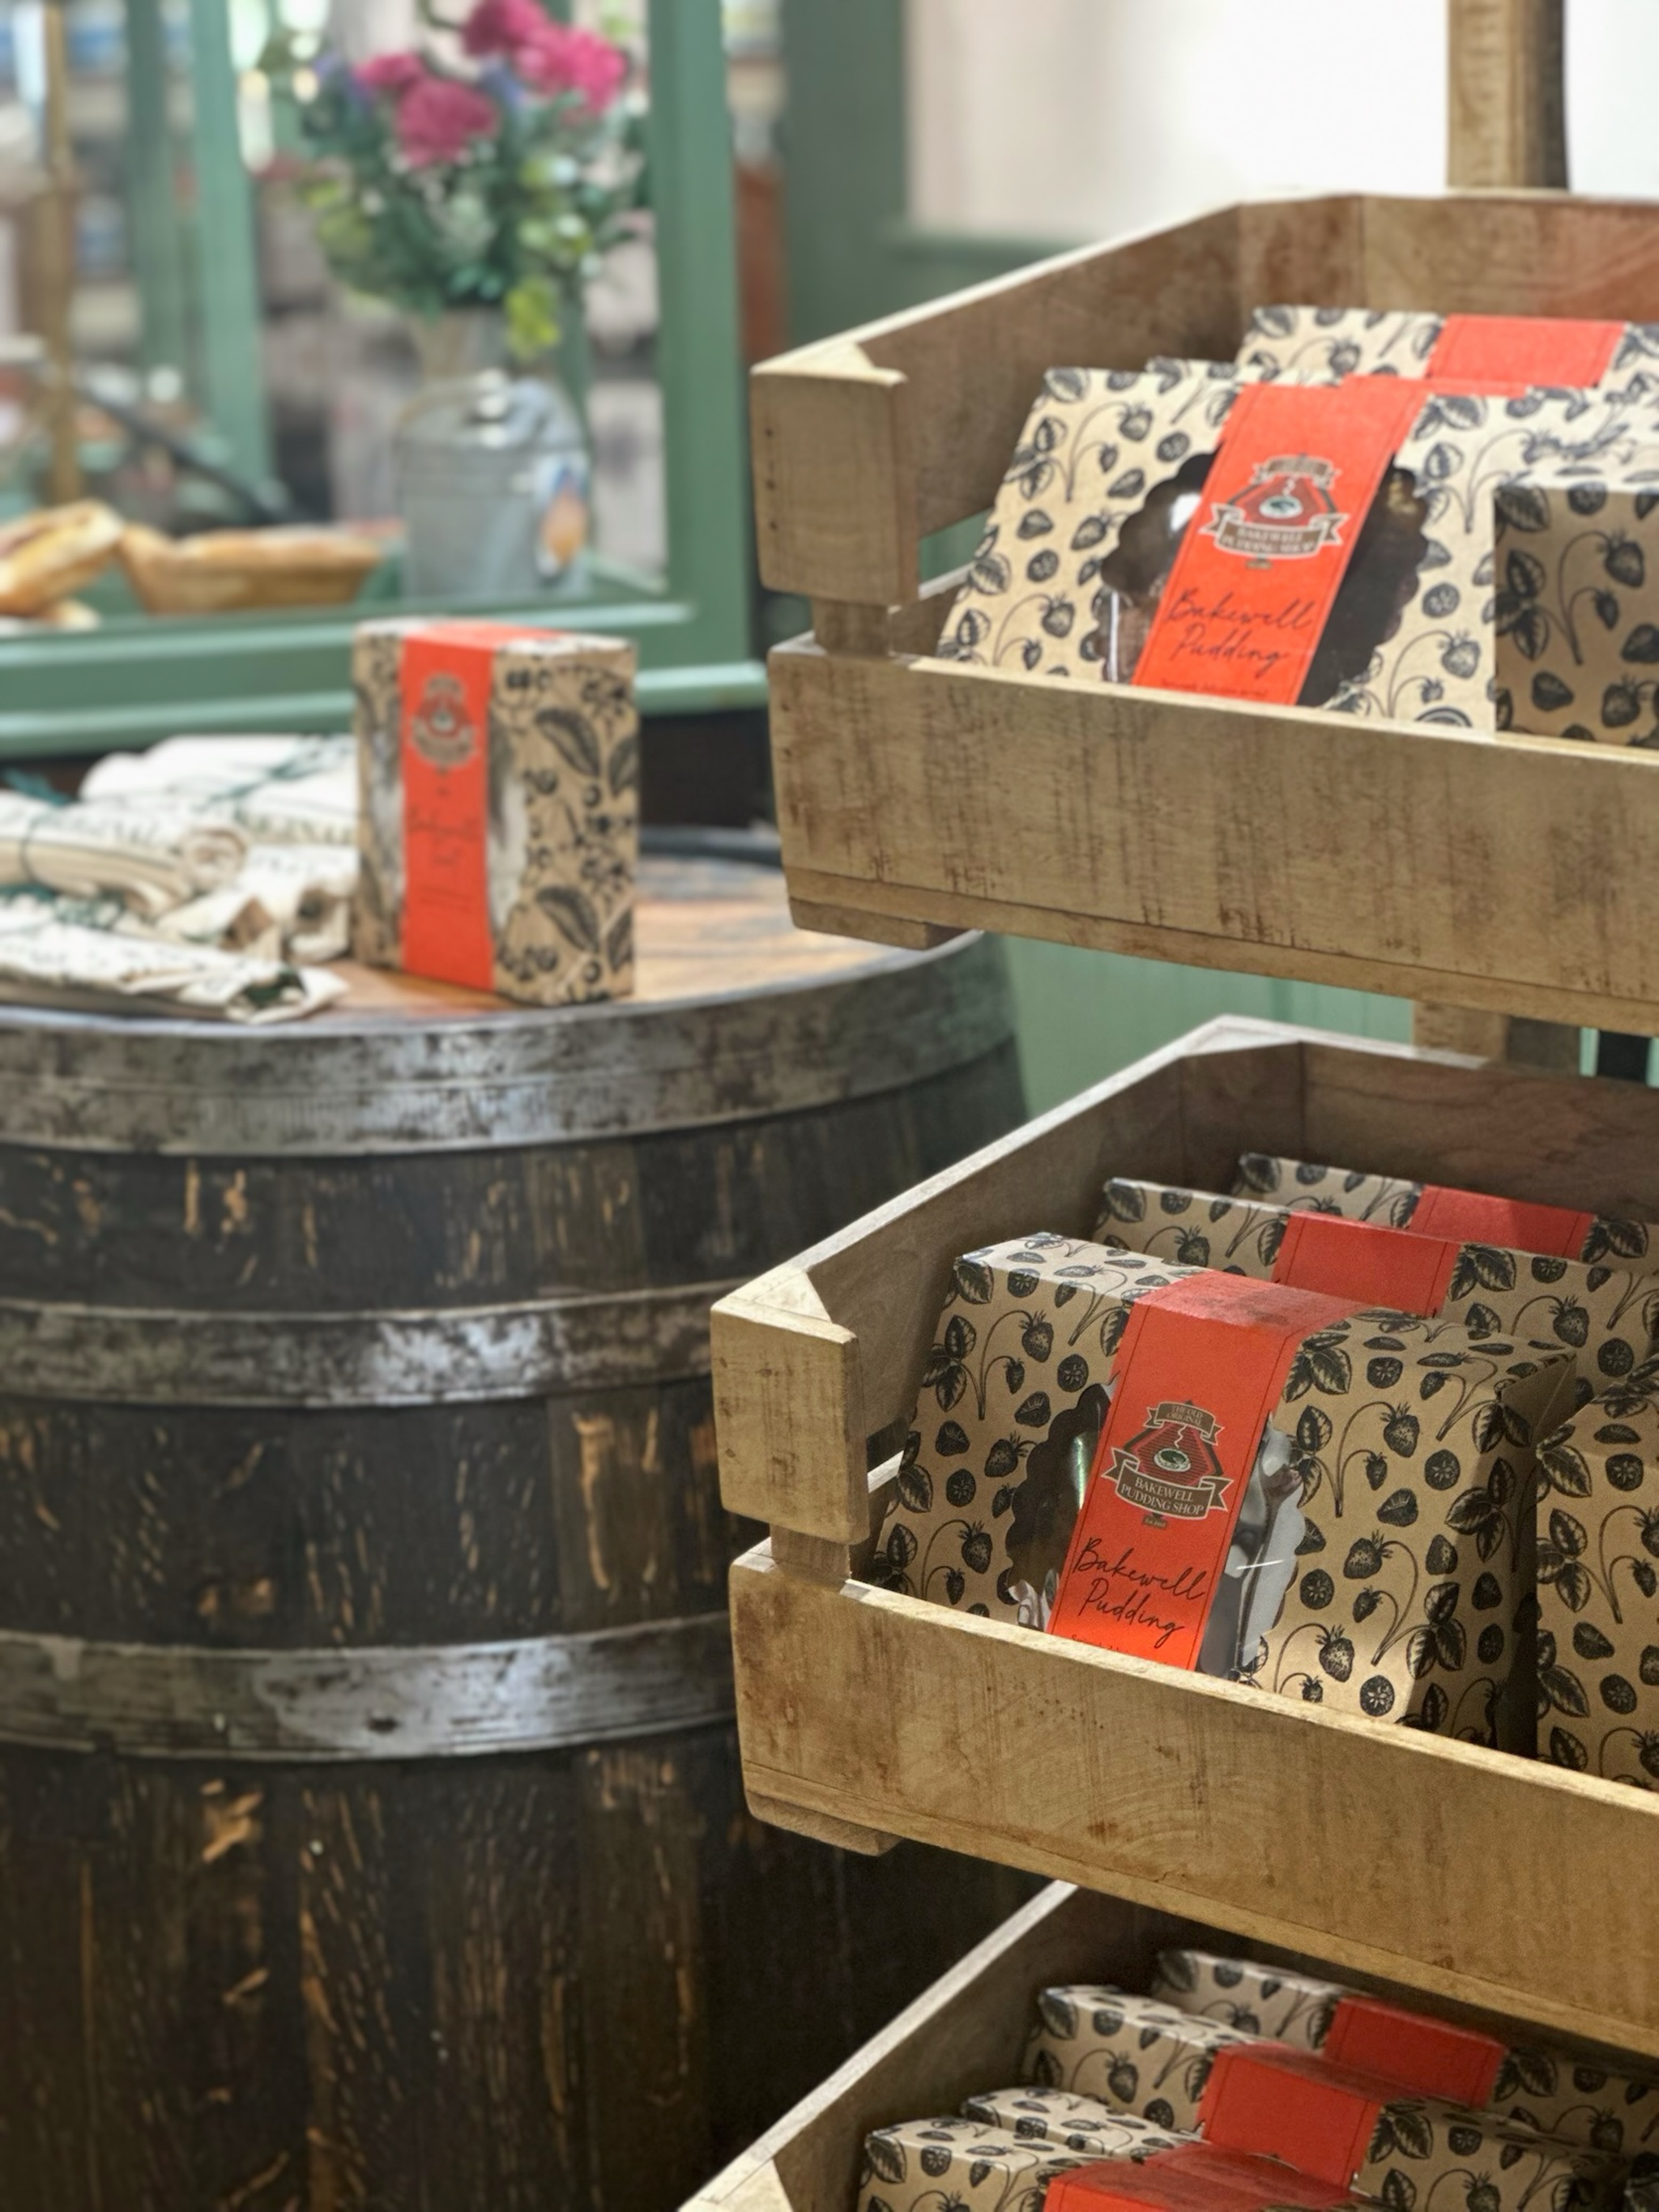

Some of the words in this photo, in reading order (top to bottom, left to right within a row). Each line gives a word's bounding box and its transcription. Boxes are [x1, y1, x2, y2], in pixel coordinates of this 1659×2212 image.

[1163, 586, 1316, 630] Bakewell
[1169, 621, 1290, 680] Pudding
[1120, 1483, 1171, 1511] PUDDING
[1173, 1502, 1205, 1516] SHOP
[1135, 1477, 1193, 1502] BAKEWELL
[1072, 1537, 1207, 1600] Bakewell
[1077, 1577, 1185, 1650] Pudding
